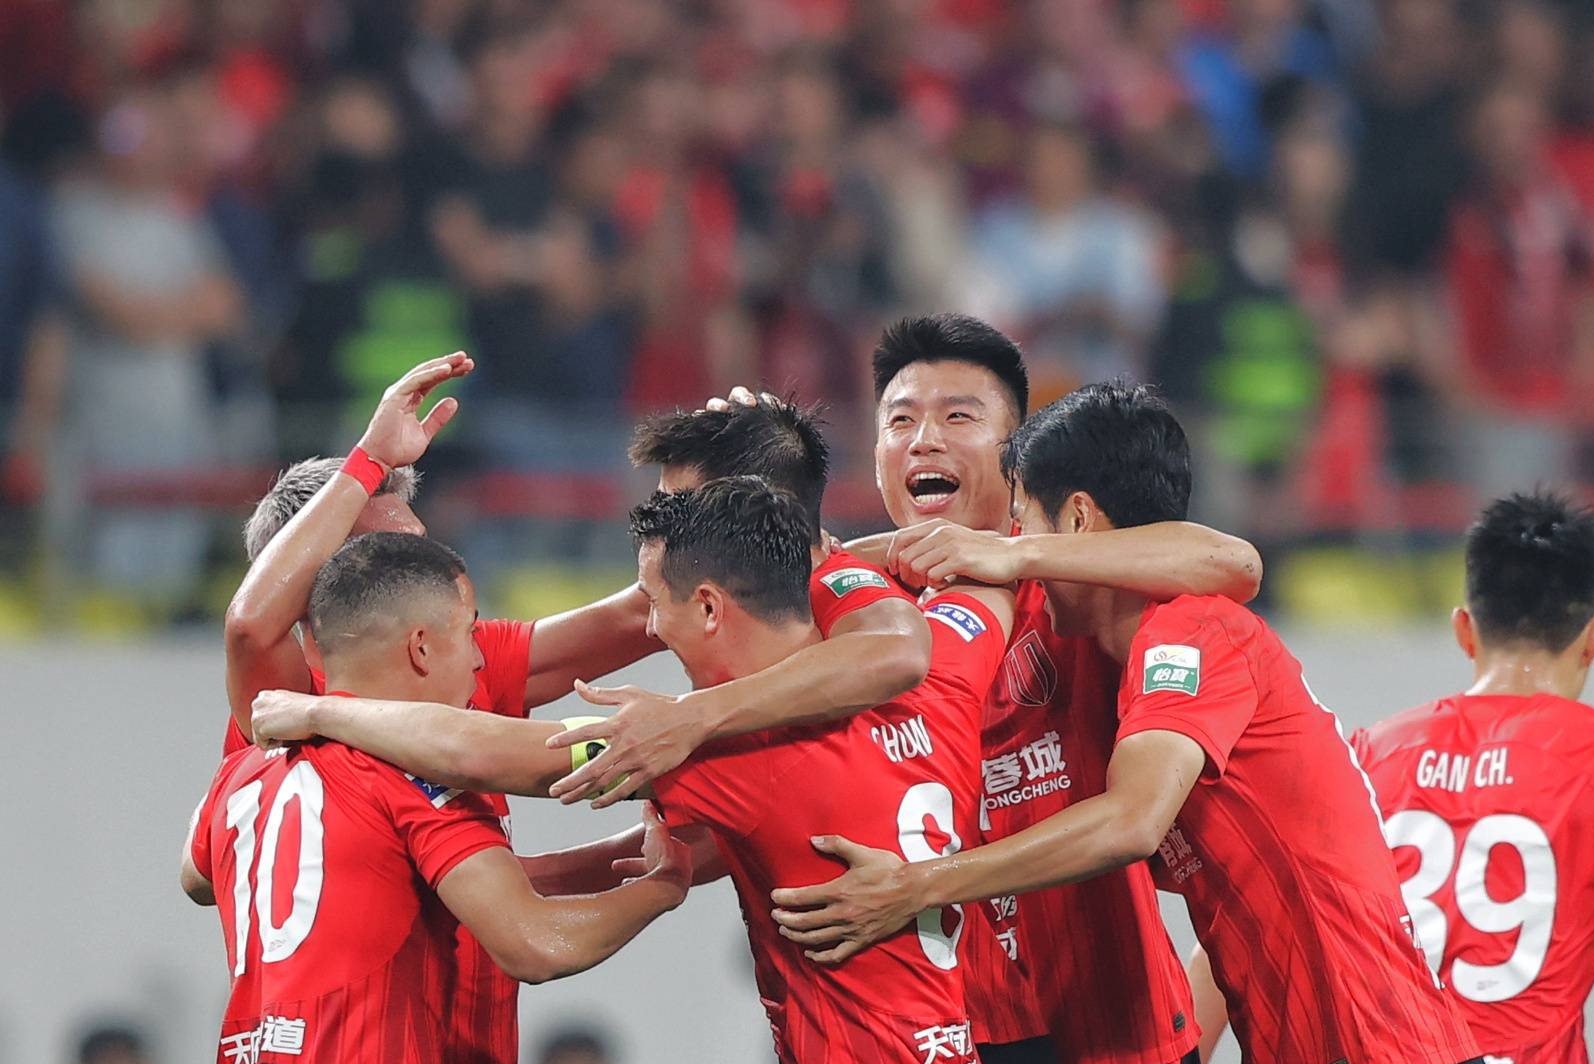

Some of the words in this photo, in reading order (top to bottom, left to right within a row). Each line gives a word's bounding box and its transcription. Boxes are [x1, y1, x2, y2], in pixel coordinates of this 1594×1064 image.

[984, 775, 1071, 810] ONGCHENG
[1416, 749, 1471, 793] GAN
[1474, 747, 1514, 788] CH.
[226, 760, 324, 977] 10
[897, 782, 964, 970] 8
[1384, 810, 1557, 1003] 39
